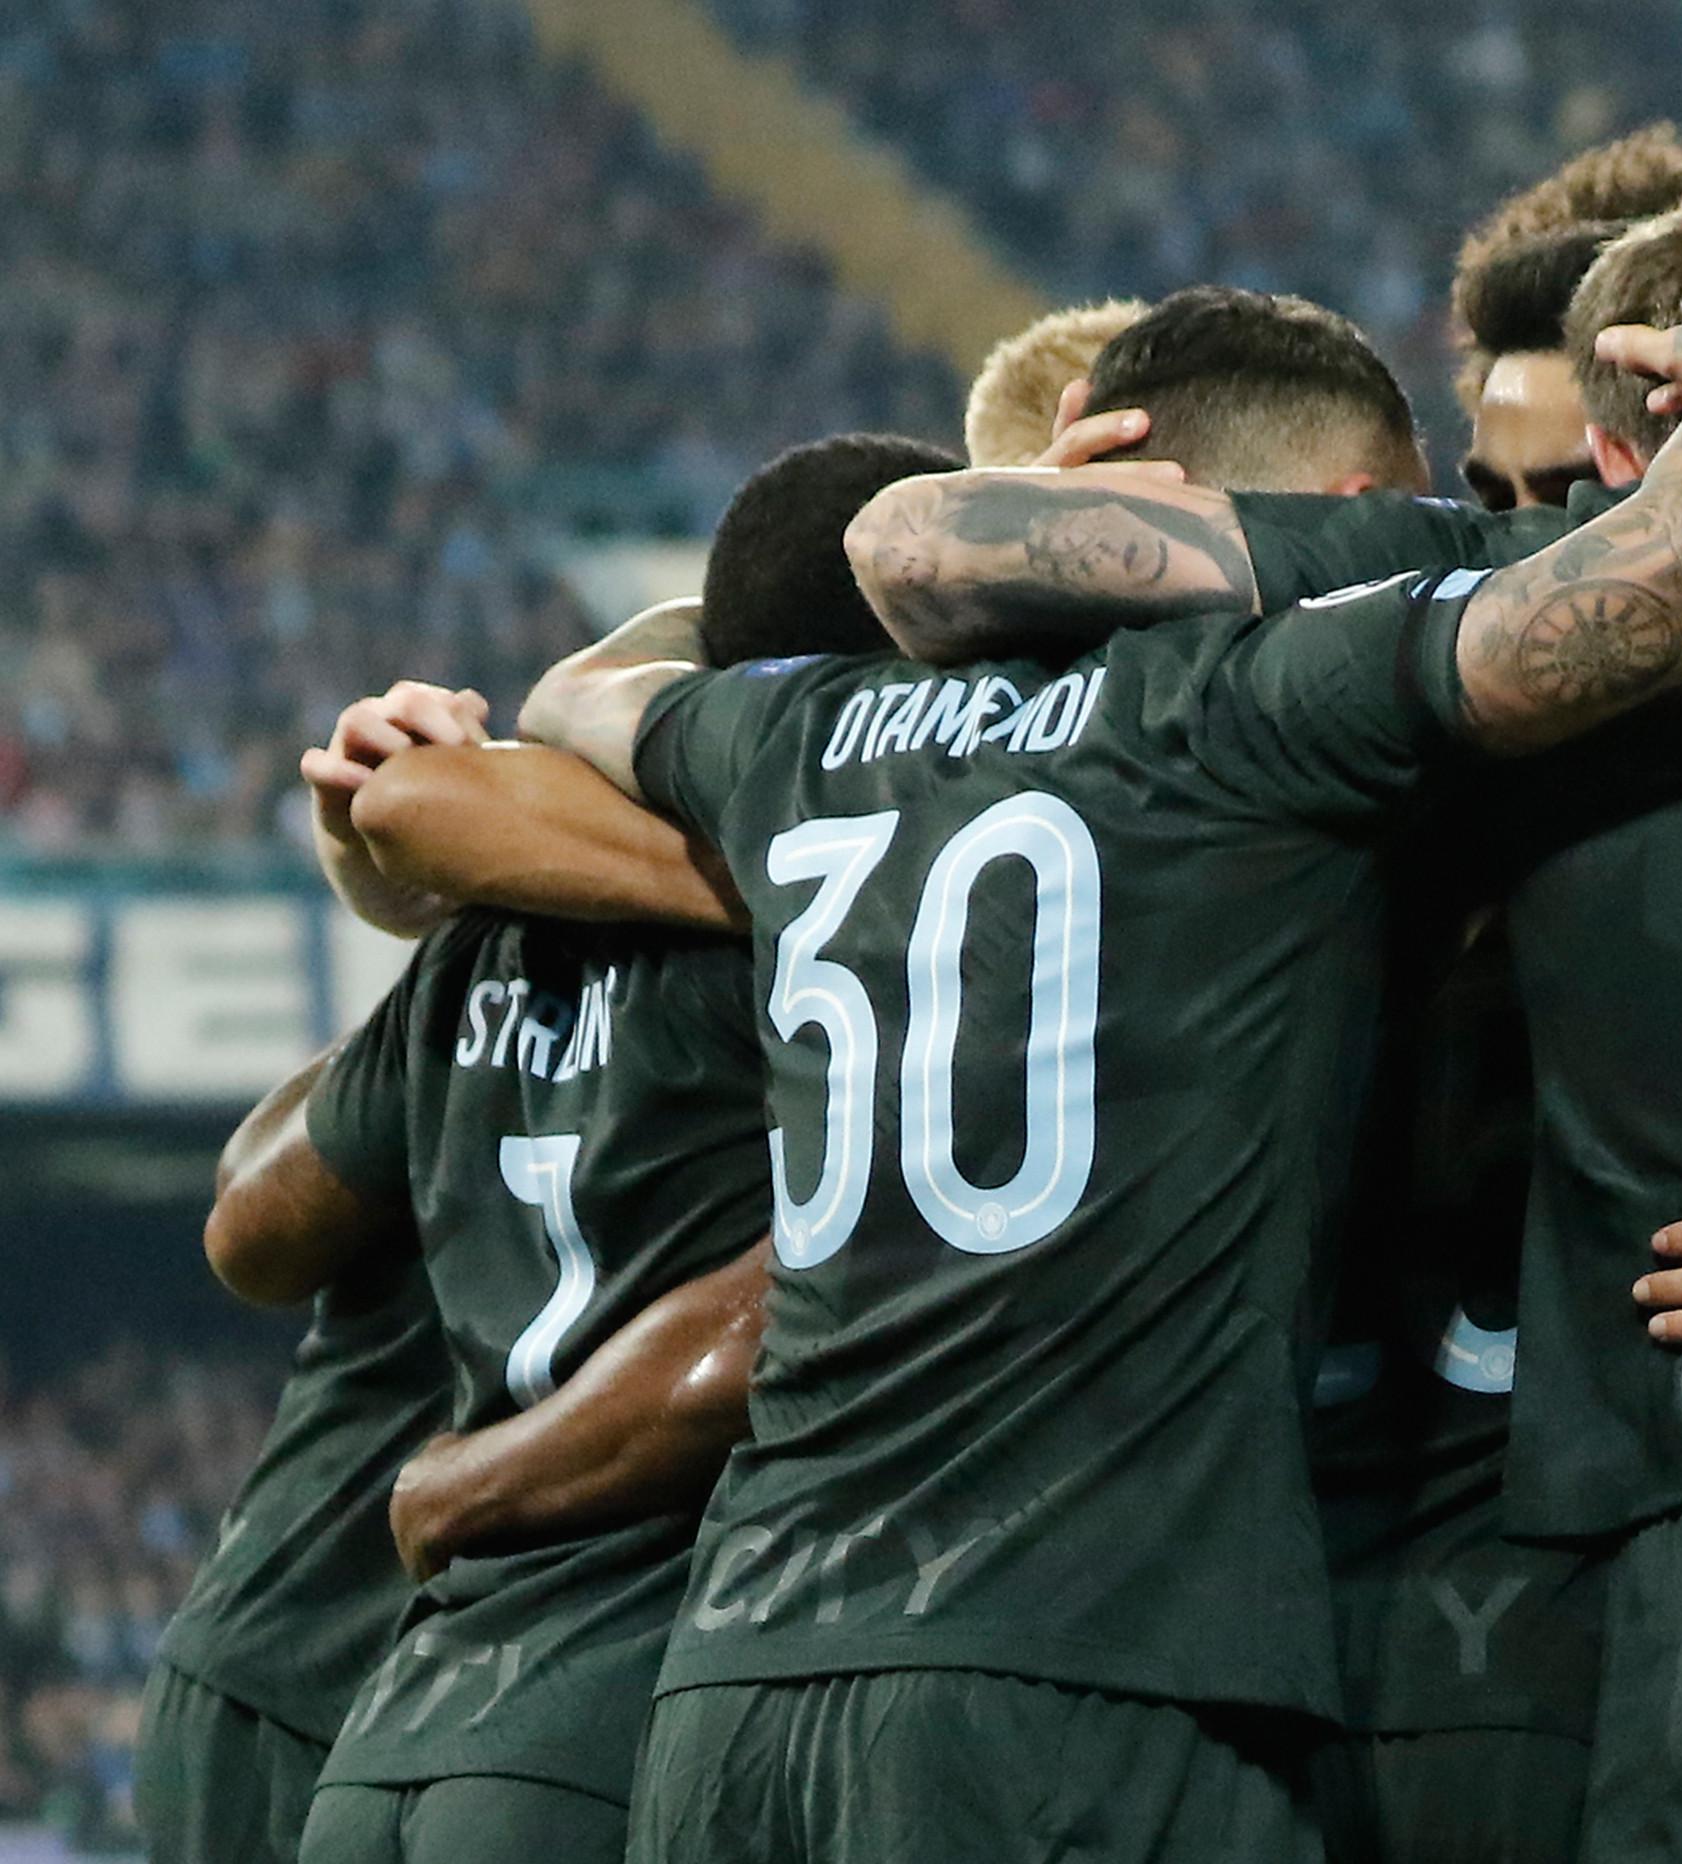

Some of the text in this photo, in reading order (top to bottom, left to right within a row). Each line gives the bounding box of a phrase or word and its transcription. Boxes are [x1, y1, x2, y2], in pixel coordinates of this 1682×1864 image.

[767, 790, 1101, 1271] 30
[499, 1134, 596, 1410] 7
[694, 1514, 1000, 1632] CITY
